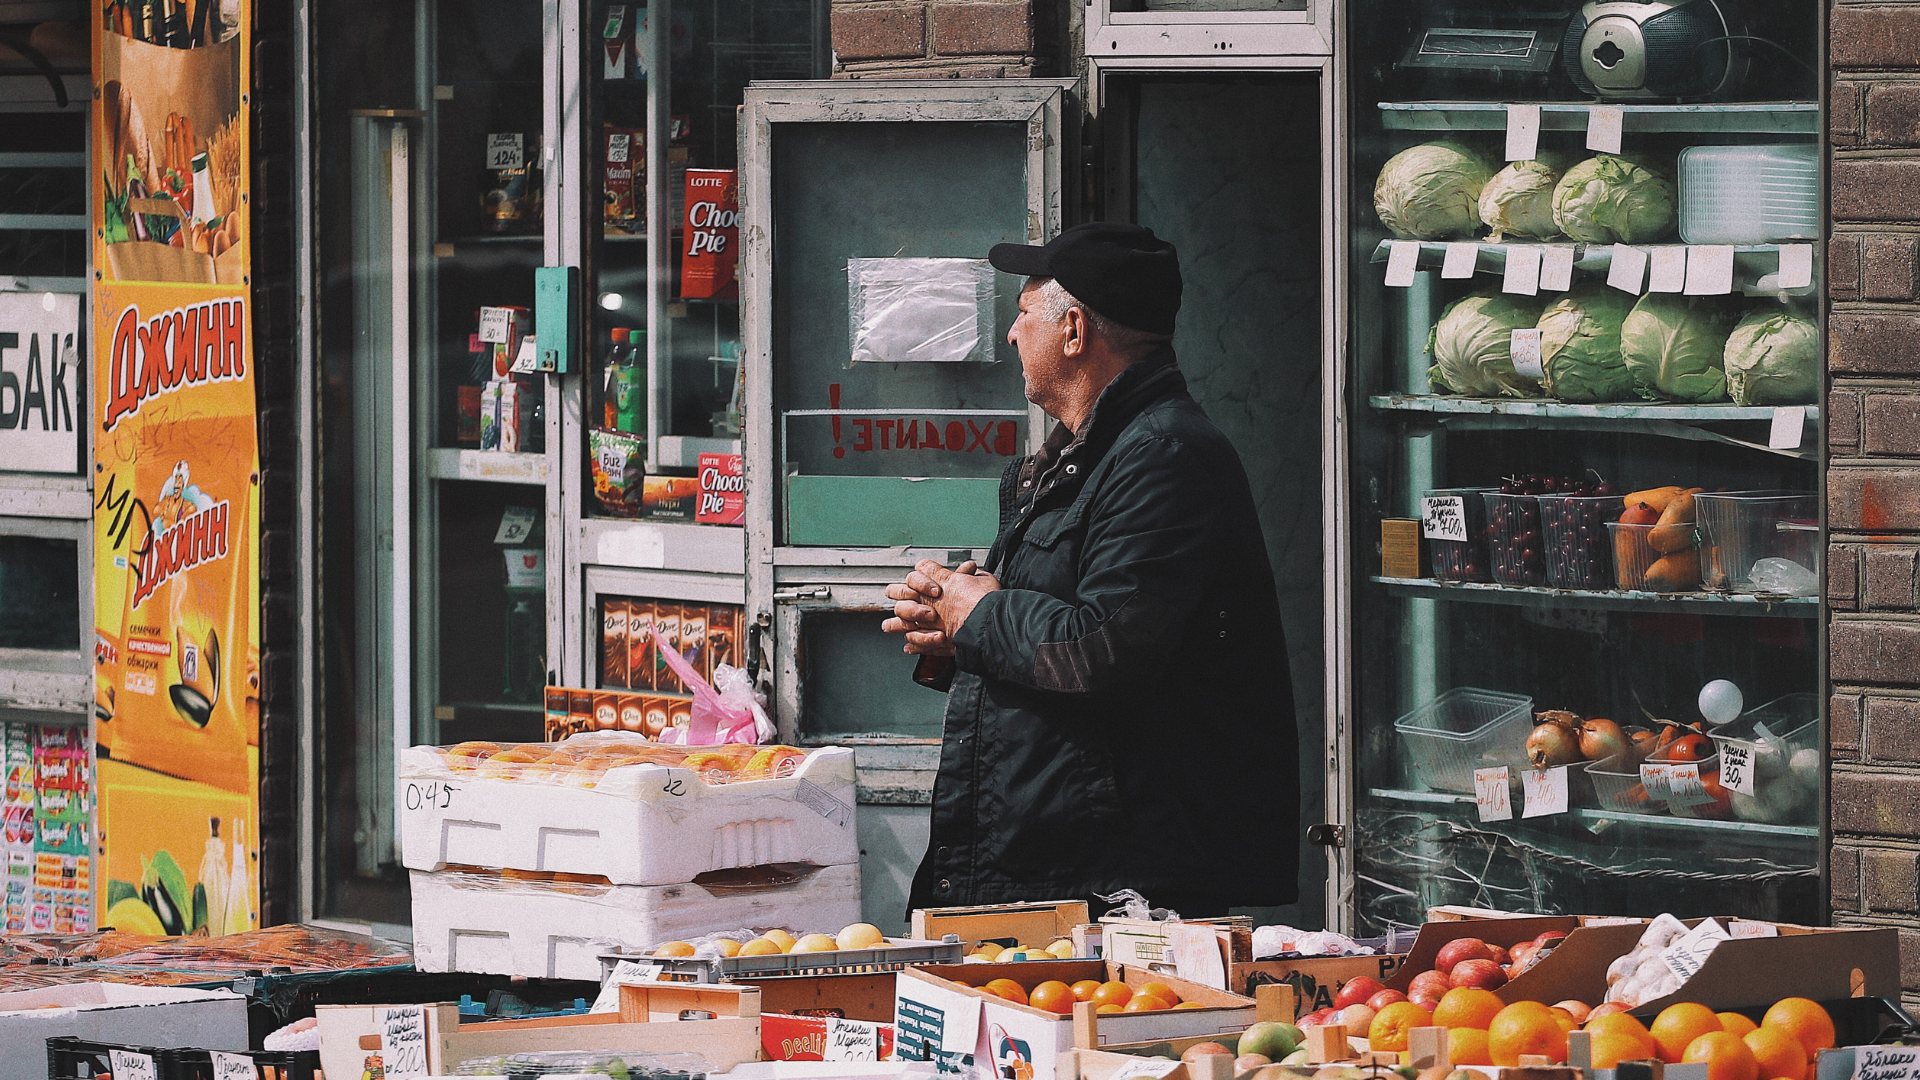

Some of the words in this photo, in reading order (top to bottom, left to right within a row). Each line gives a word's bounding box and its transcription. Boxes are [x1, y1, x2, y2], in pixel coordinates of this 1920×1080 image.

[690, 178, 722, 187] LOTTE
[688, 229, 726, 256] Pie
[603, 453, 620, 467] Биг
[702, 457, 720, 466] LOTTE
[701, 467, 744, 491] Choco
[699, 491, 724, 515] Pie
[130, 624, 161, 637] семечки
[127, 654, 159, 672] обжарки
[1858, 1050, 1916, 1073] Яблоки
